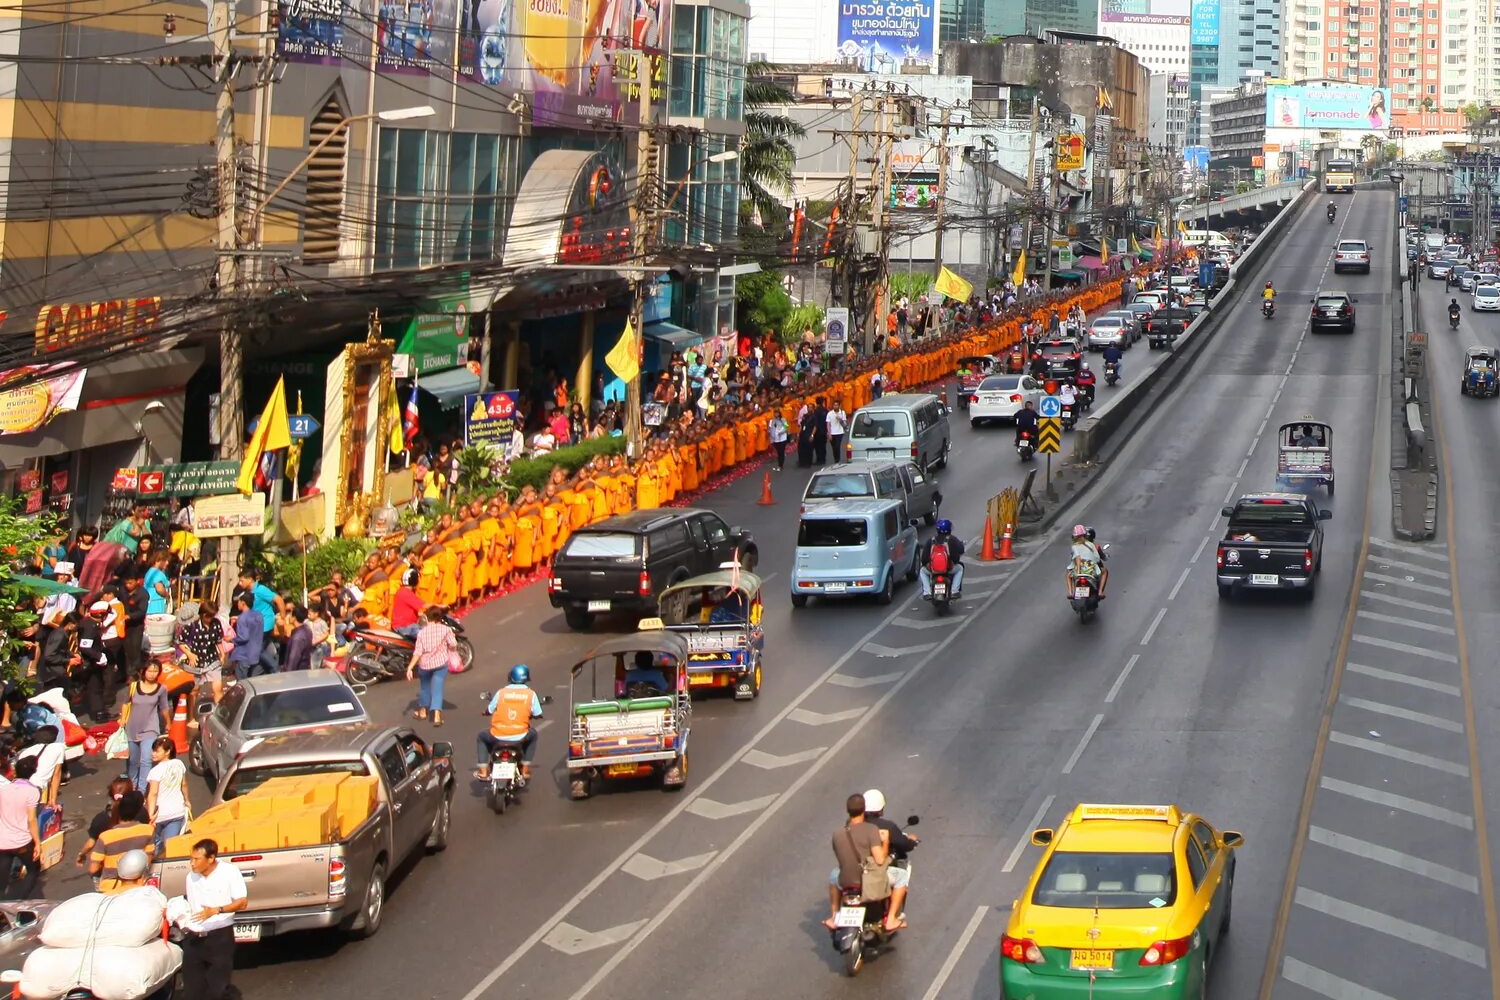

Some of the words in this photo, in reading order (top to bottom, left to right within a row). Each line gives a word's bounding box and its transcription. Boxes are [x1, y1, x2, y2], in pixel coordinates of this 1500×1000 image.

[1305, 107, 1360, 119] lemonade
[1059, 156, 1081, 164] Kodak
[423, 353, 452, 370] EXCHANGE
[488, 404, 512, 416] 43.6
[294, 419, 309, 432] 21
[124, 476, 138, 488] 79
[235, 924, 258, 934] 8047
[1089, 951, 1112, 962] 5014
